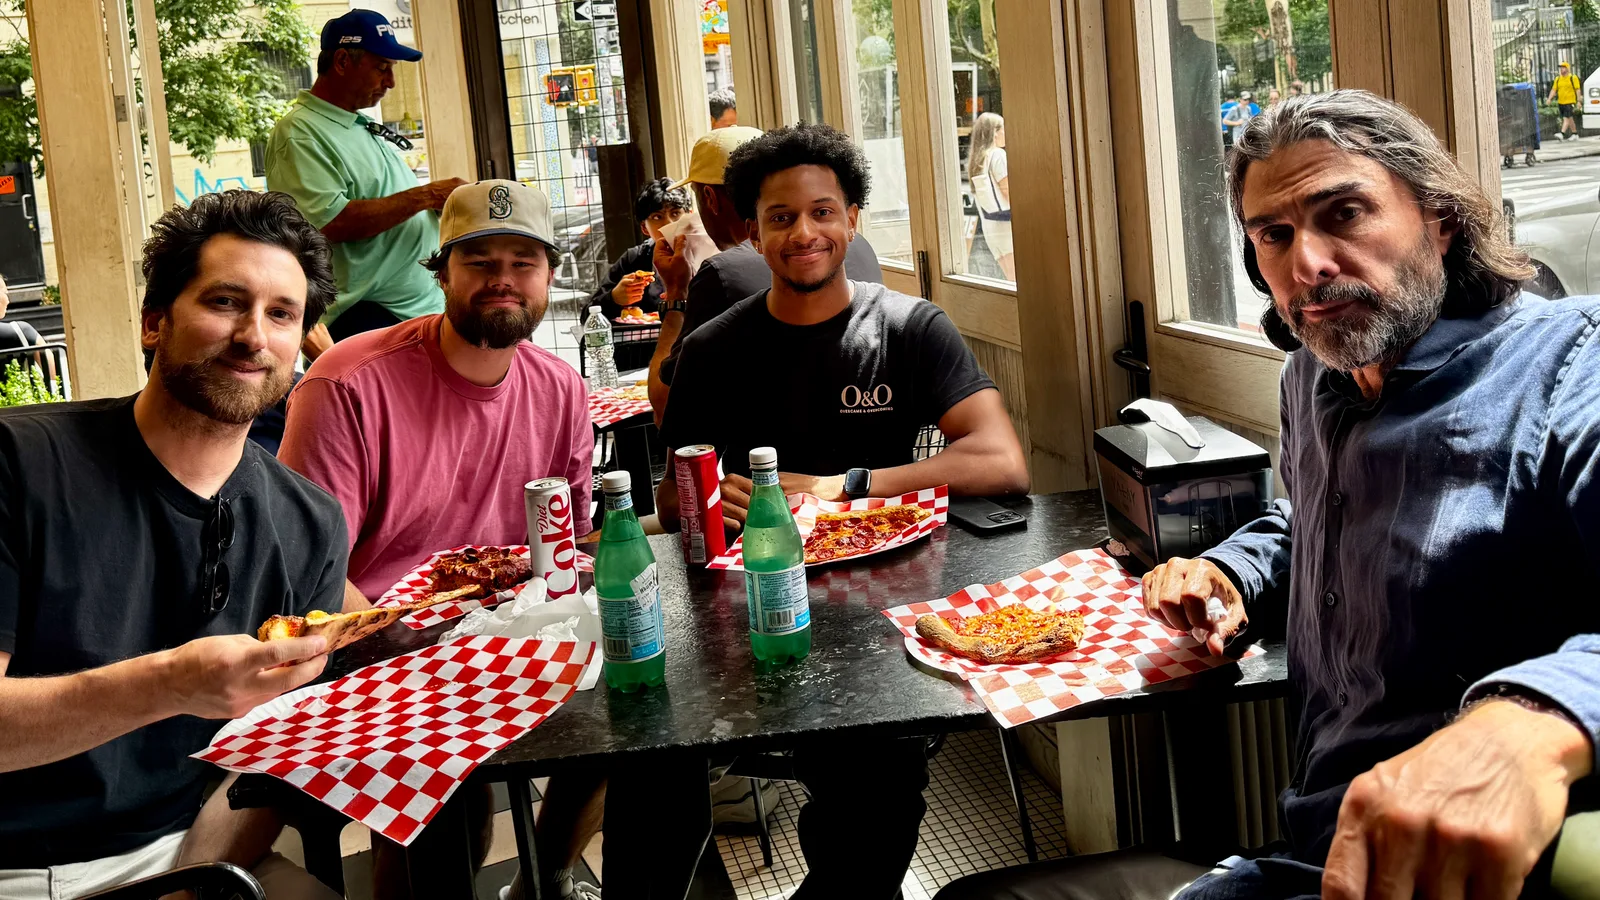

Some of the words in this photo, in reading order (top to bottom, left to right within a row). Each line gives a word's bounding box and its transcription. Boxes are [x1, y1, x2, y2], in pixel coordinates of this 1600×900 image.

[841, 384, 892, 407] O&O
[536, 504, 548, 533] Diet
[541, 490, 577, 600] Coke
